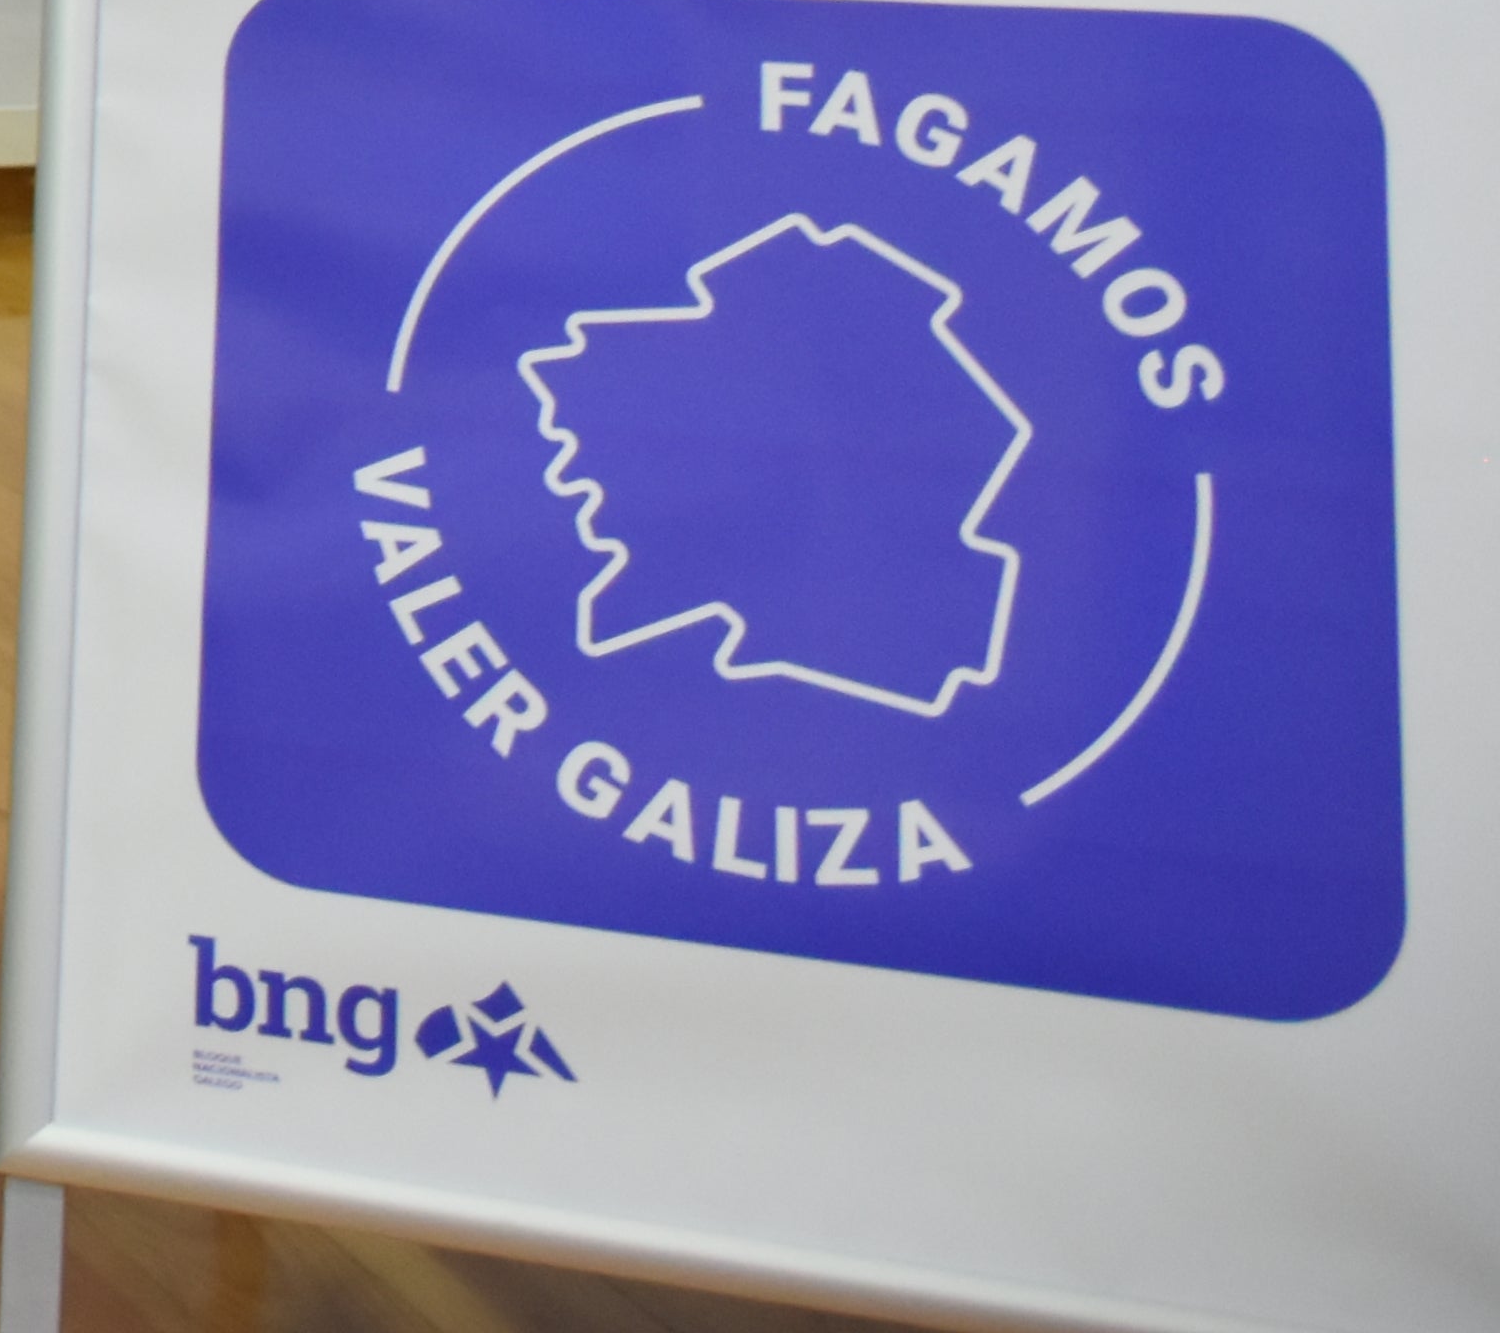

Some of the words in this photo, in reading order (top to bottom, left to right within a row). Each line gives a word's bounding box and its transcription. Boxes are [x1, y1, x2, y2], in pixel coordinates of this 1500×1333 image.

[760, 62, 1226, 410] FAGAMOS
[353, 445, 549, 758] VALER
[556, 740, 972, 884] GALIZA
[188, 935, 399, 1077] bng
